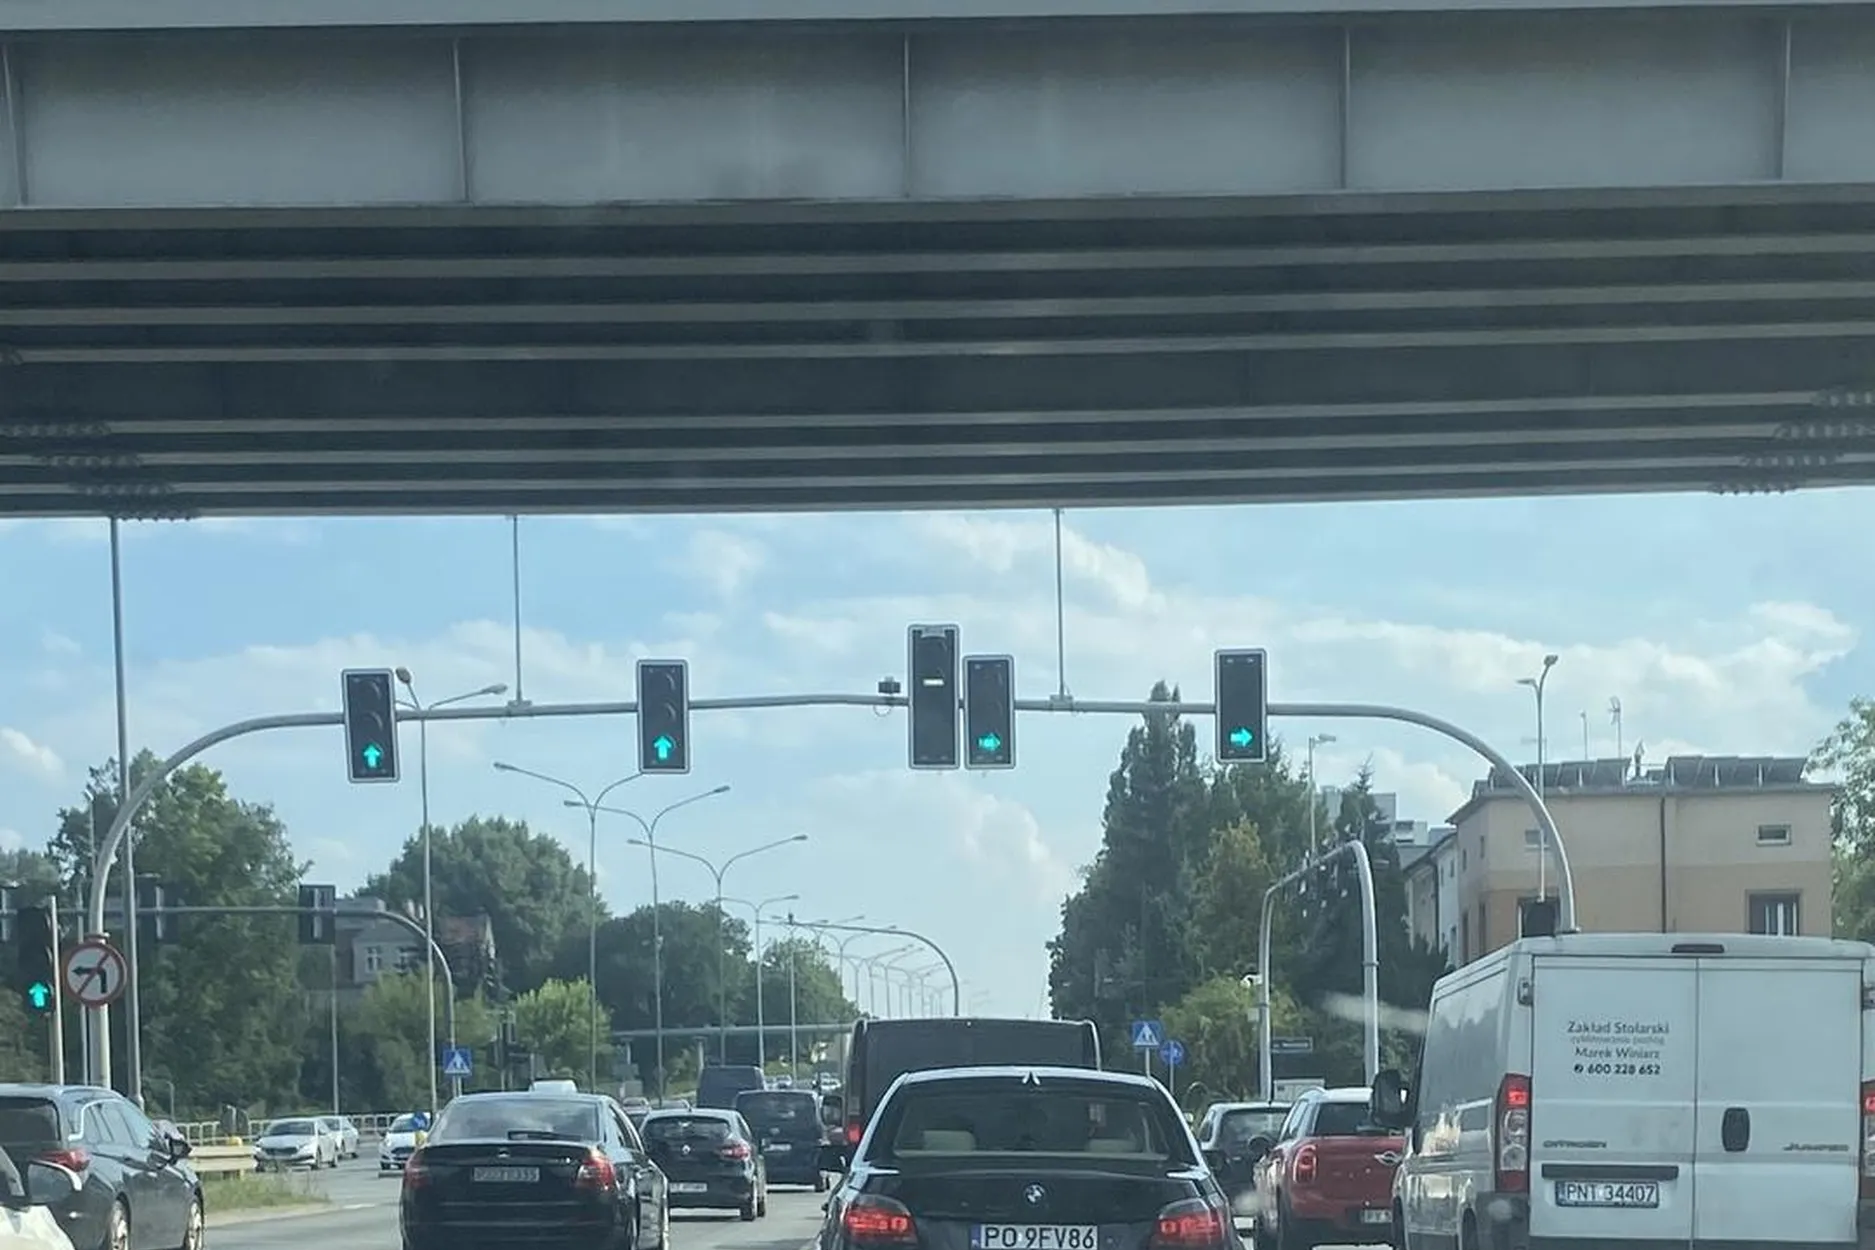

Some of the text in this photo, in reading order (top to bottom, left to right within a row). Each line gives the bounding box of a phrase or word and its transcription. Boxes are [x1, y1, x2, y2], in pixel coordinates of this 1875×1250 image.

[1614, 1021, 1669, 1034] Stolarski
[1574, 1046, 1612, 1058] Marek
[1587, 1063, 1611, 1074] 600
[1639, 1064, 1661, 1075] 652
[1566, 1183, 1655, 1202] PNT 34407
[984, 1226, 1095, 1250] PO 9FV86
